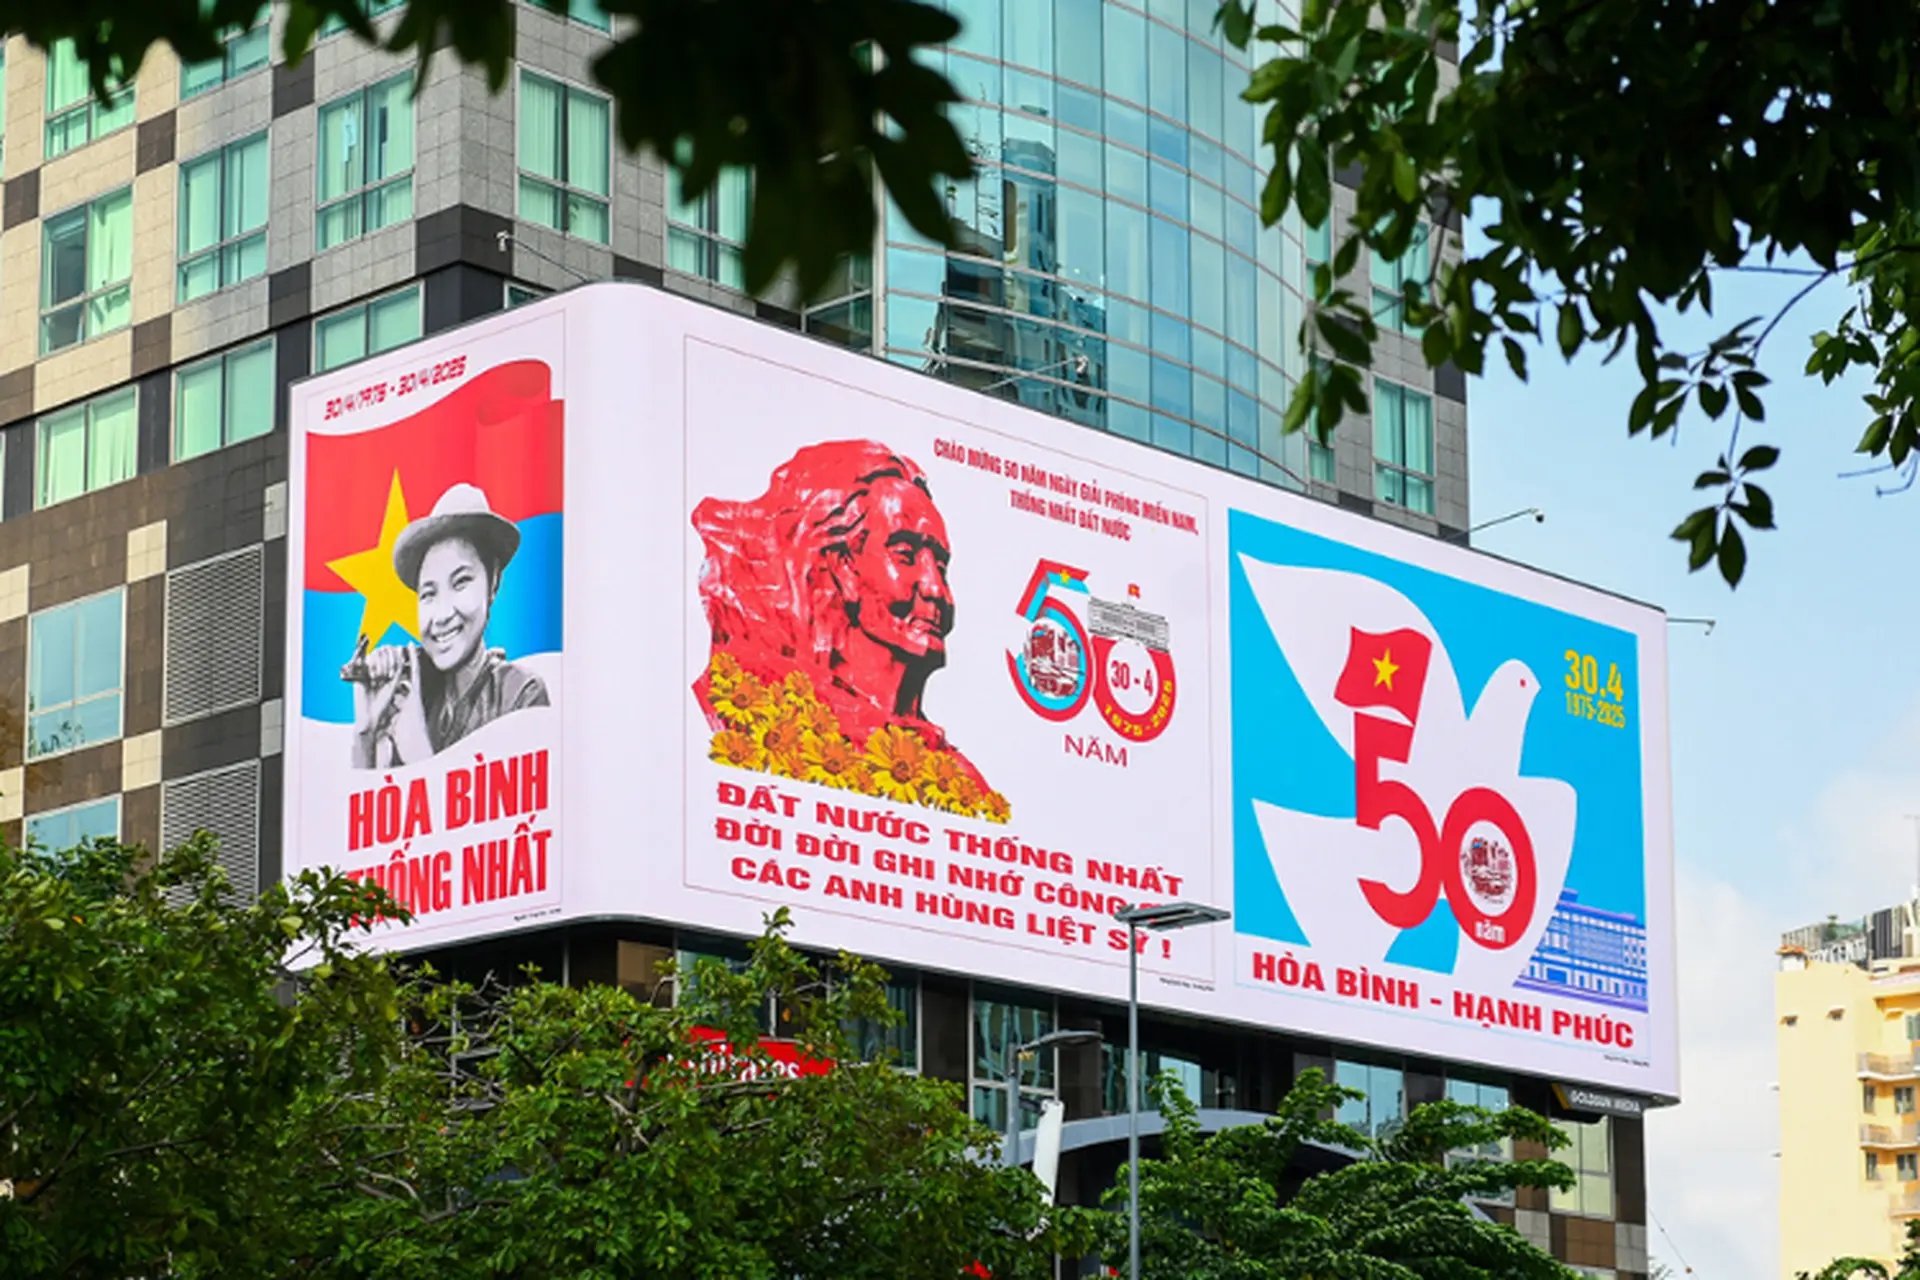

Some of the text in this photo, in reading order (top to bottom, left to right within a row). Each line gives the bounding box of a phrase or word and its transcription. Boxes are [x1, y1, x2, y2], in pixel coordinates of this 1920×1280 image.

[1004, 460, 1018, 479] 50
[1021, 464, 1046, 488] NĂM
[1111, 660, 1130, 691] 30
[1144, 669, 1154, 697] 4
[1564, 648, 1624, 702] 30.4
[1063, 733, 1128, 767] NĂM
[348, 749, 549, 851] HÒA BÌNH
[717, 781, 1184, 896] ĐẤT NƯỚC THỐNG NHẤT
[1353, 711, 1537, 951] 50
[462, 814, 552, 906] NHẤT
[715, 817, 782, 851] ĐỜI
[796, 832, 860, 865] ĐỜI
[874, 849, 935, 880] GHI
[948, 869, 1024, 896] NHỚ
[731, 857, 811, 891] CÁC
[823, 874, 903, 910] ANH
[916, 891, 1015, 930] HÙNG
[1027, 915, 1097, 945] LIỆT
[1252, 951, 1325, 992] HÒA
[1336, 965, 1419, 1009] BÌNH
[1453, 990, 1542, 1032] HẠNH
[1552, 1007, 1634, 1049] PHÚC
